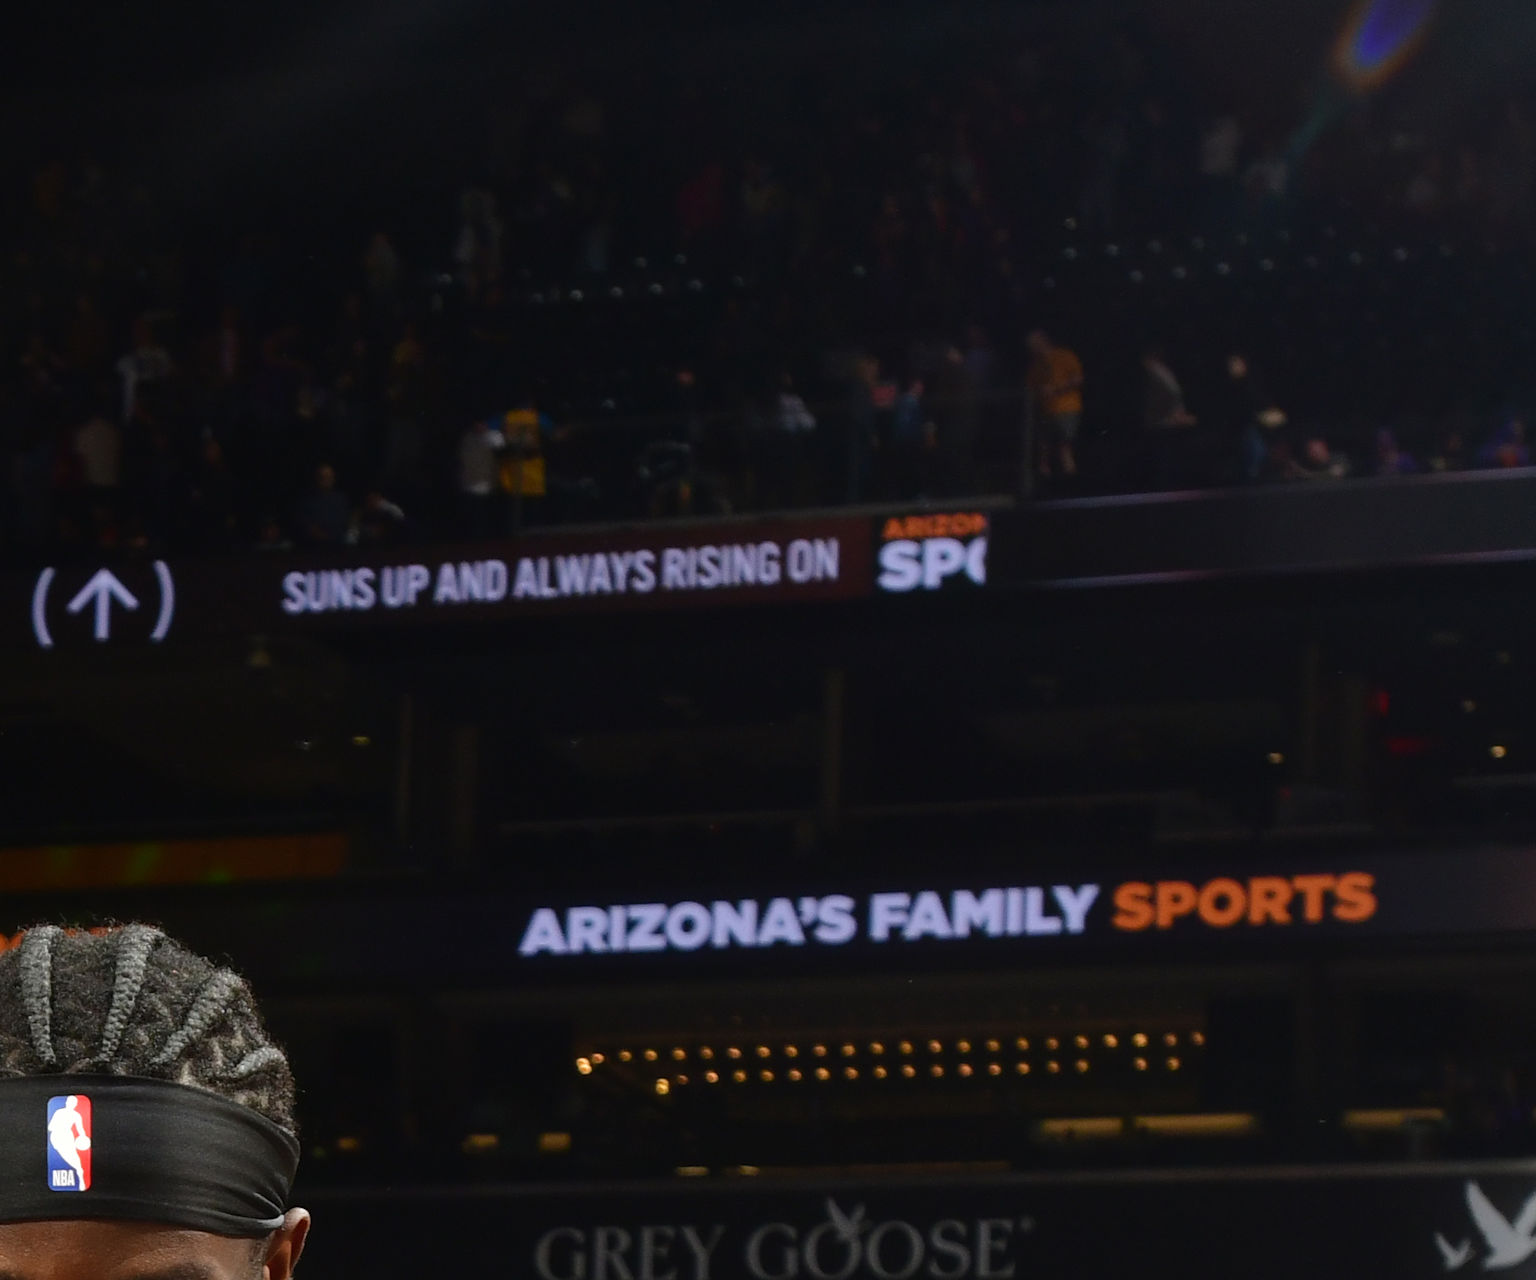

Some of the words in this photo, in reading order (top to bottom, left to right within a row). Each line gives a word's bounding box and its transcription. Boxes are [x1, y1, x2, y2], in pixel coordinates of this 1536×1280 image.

[281, 566, 377, 615] SUNS
[380, 563, 431, 609] UP
[433, 558, 508, 605] AND
[511, 547, 657, 600] ALWAYS
[660, 539, 782, 592] RISING
[786, 536, 842, 583] ON
[517, 893, 857, 956] ARIZONA'S
[867, 883, 1100, 942] FAMILY
[1111, 871, 1378, 932] SPORTS
[52, 1169, 75, 1187] NBA
